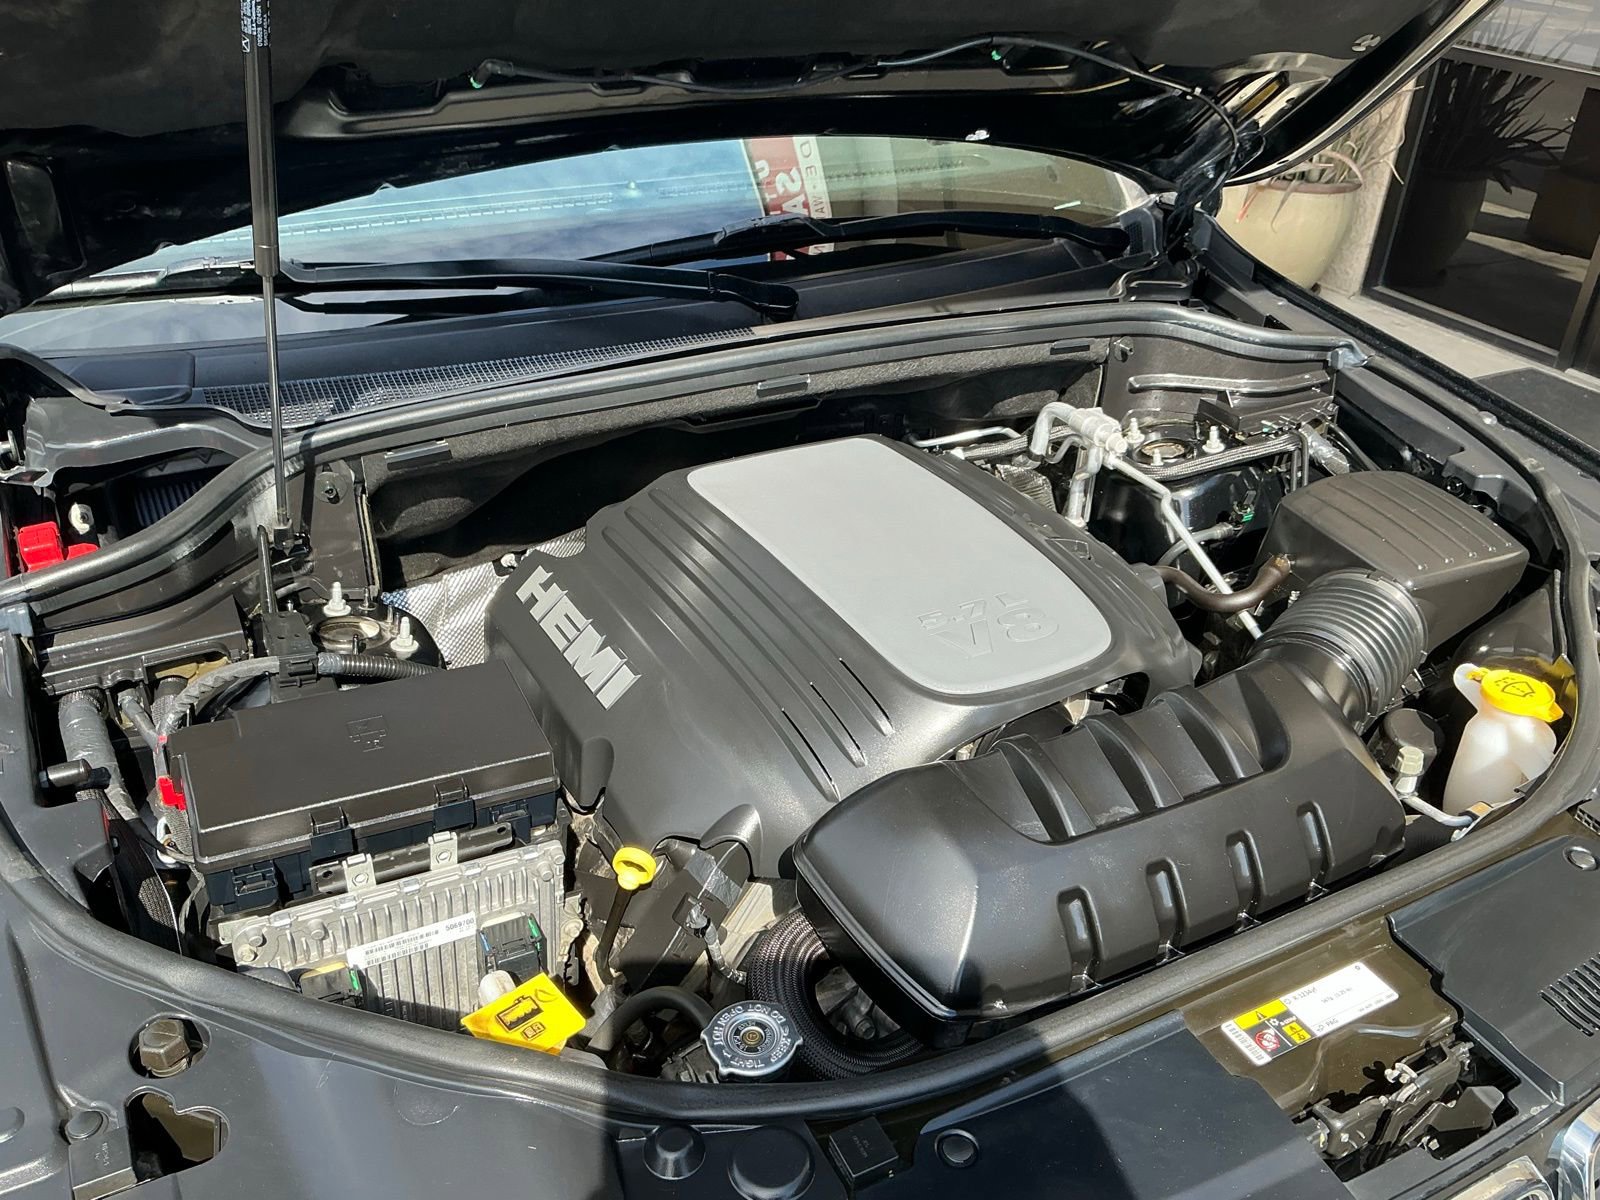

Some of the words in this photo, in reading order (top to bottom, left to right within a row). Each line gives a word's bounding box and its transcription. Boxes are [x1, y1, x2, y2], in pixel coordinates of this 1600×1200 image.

[516, 565, 641, 710] HEMI
[928, 607, 1060, 659] V8
[717, 1005, 744, 1027] OPEN
[747, 1004, 771, 1015] NOT
